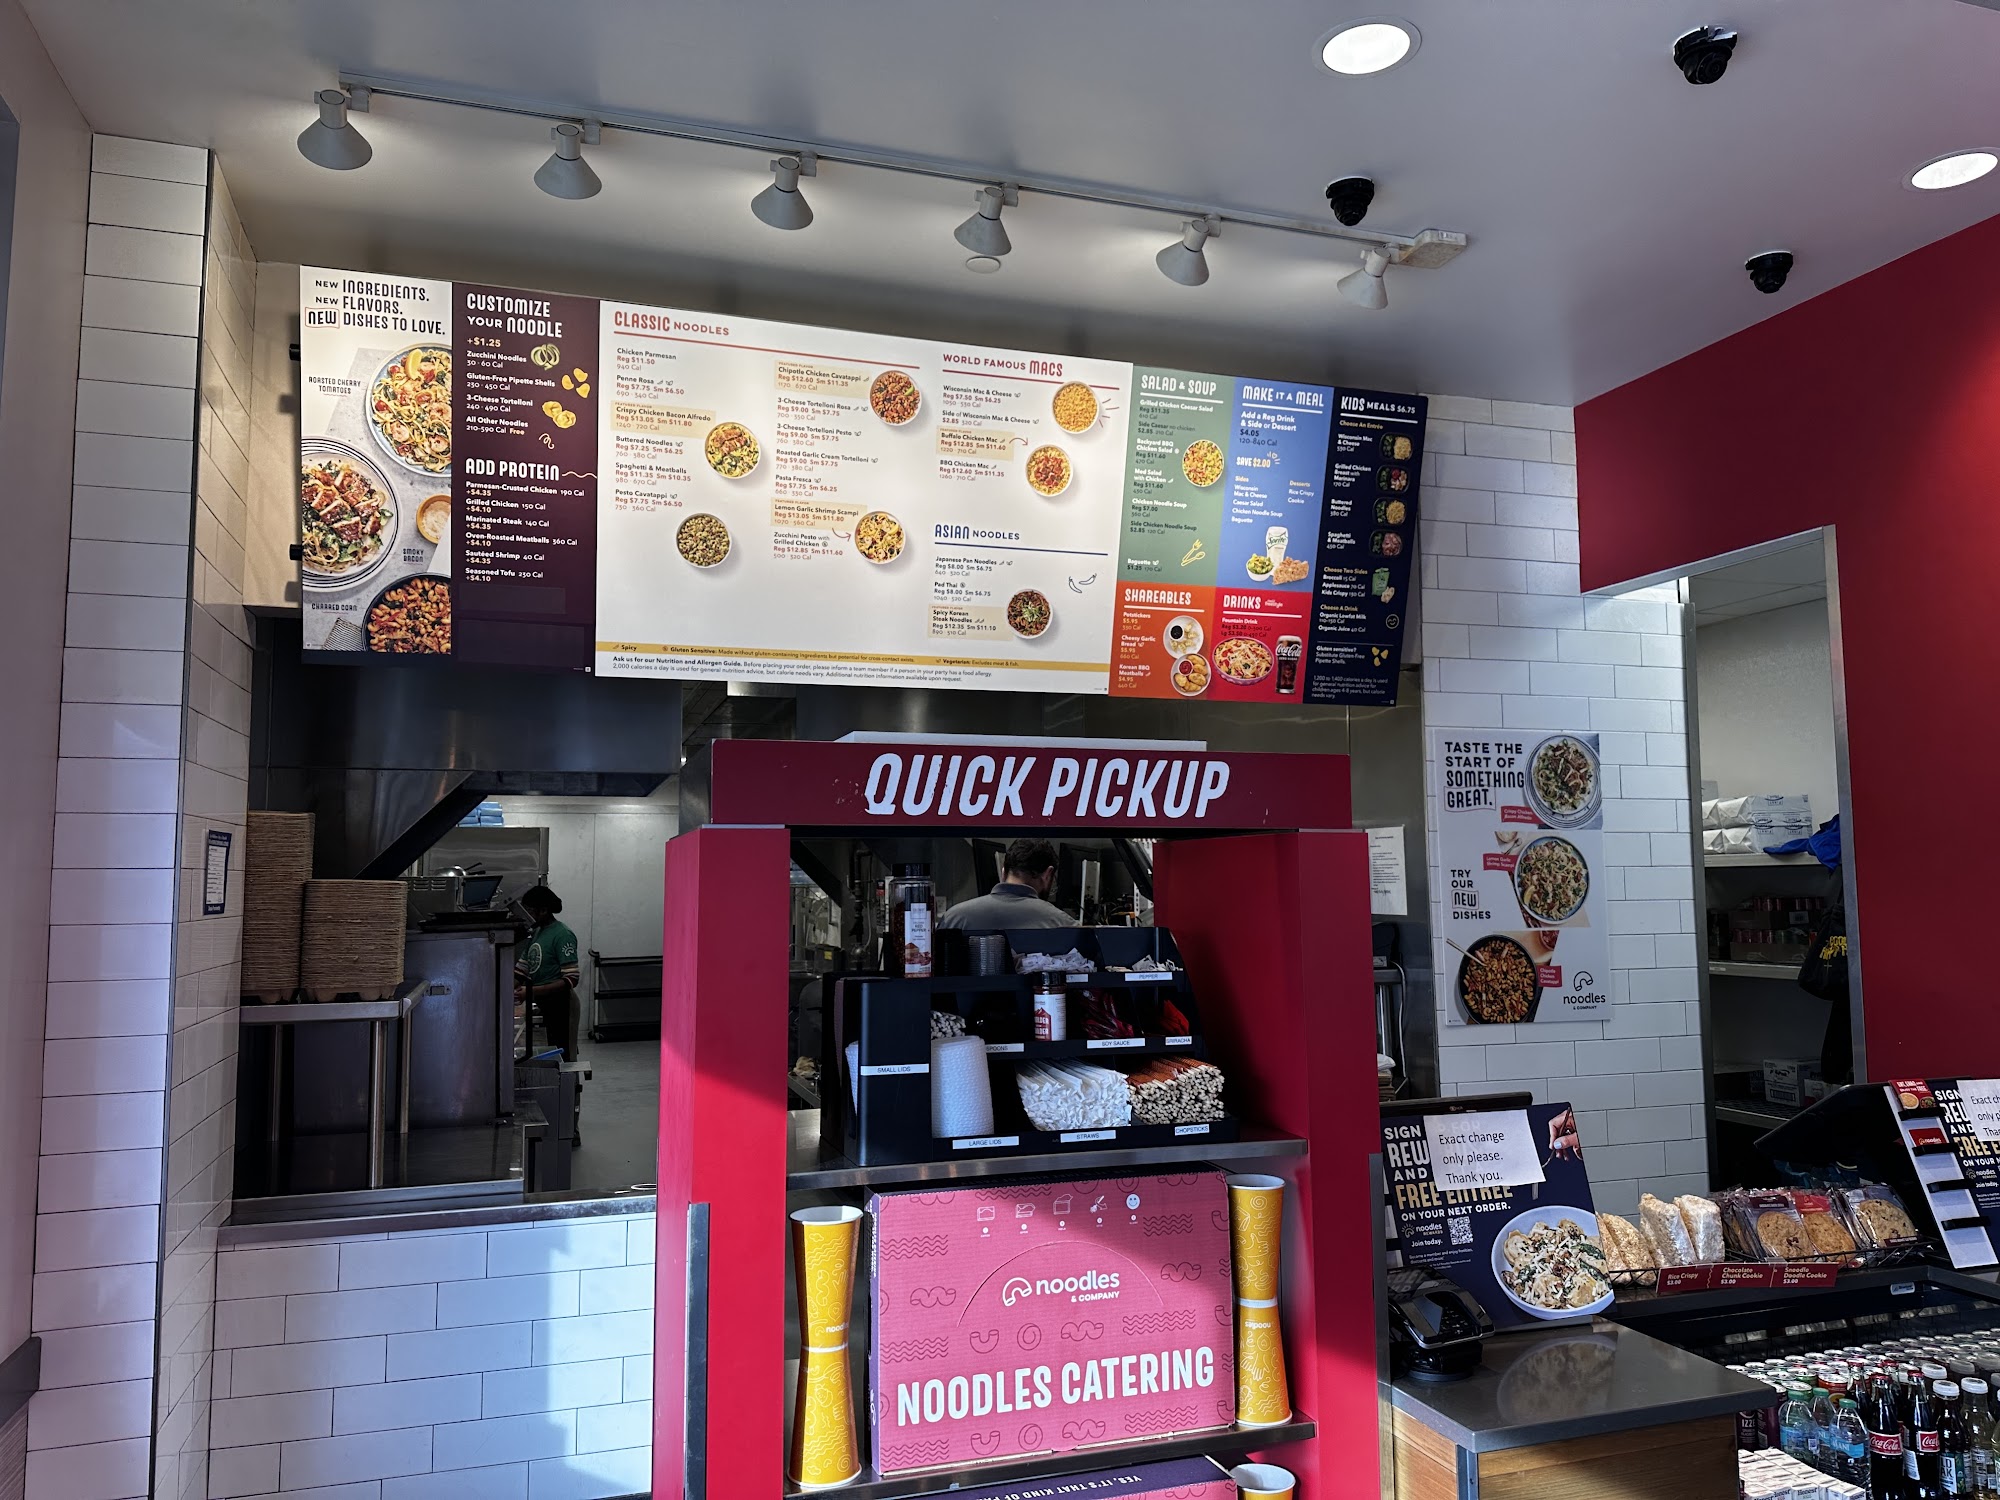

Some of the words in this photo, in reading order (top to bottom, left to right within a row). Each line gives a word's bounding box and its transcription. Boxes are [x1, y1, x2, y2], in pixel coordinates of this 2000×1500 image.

[315, 279, 338, 289] NEW
[342, 279, 429, 302] INGREDIENTS.
[315, 296, 338, 305] NEW
[343, 296, 403, 315] FLAVORS.
[466, 293, 551, 317] CUSTOMIZE
[308, 310, 337, 326] NEW
[343, 313, 390, 330] DISHES
[393, 316, 407, 331] TO
[411, 318, 446, 335] LOVE.
[467, 315, 502, 329] YOUR
[506, 317, 562, 338] NOODLE
[614, 311, 670, 332] CLASSIC
[674, 321, 730, 336] NOODLES
[467, 337, 501, 347] +$1.25
[466, 351, 496, 360] Zucchini
[497, 353, 527, 362] Noodles
[617, 348, 644, 357] Chicken
[645, 350, 677, 360] Parmesan
[617, 355, 630, 364] Reg
[943, 354, 981, 365] WORLD
[984, 358, 1026, 370] FAMOUS
[1029, 360, 1063, 377] MACS
[466, 372, 507, 383] Gluten-Free
[509, 375, 533, 386] Pipette
[534, 378, 555, 387] Shells
[778, 367, 804, 376] Chipotle
[805, 369, 830, 378] Chicken
[831, 372, 861, 382] Cavatappi
[309, 376, 335, 387] ROASTED
[337, 378, 361, 388] CHERRY
[1141, 374, 1177, 392] SALAD
[1179, 382, 1185, 390] &
[1187, 380, 1217, 396] SOUP
[318, 385, 351, 395] TOMATOES
[1243, 385, 1274, 402] MAKE
[1276, 392, 1285, 400] IT
[1286, 393, 1293, 401] A
[1295, 391, 1324, 407] MEAL
[466, 394, 498, 404] 3-Cheese
[499, 396, 533, 406] Tortelloni
[1340, 395, 1365, 412] KIDS
[1366, 402, 1395, 412] MEALS
[1397, 405, 1416, 414] $6.75
[616, 407, 637, 416] Crispy
[638, 408, 665, 417] Chicken
[666, 411, 686, 419] Bacon
[687, 413, 711, 422] Alfredo
[1241, 411, 1256, 420] Add
[1263, 413, 1275, 423] Reg
[1276, 414, 1295, 423] Drink
[1247, 420, 1263, 429] Side
[1271, 422, 1297, 431] Dessert
[1240, 428, 1259, 437] $4.05
[616, 435, 644, 444] Buttered
[645, 438, 673, 447] Noodles
[1236, 456, 1252, 467] SAVE
[1253, 457, 1271, 468] $2.00
[466, 458, 495, 476] ADD
[499, 460, 560, 481] PROTEIN
[466, 481, 528, 493] Parmesan-Crusted
[530, 485, 557, 495] Chicken
[574, 488, 585, 496] Cal
[466, 498, 489, 508] Grilled
[491, 500, 519, 509] Chicken
[815, 507, 836, 515] Shrimp
[837, 509, 859, 517] Scampi
[934, 524, 970, 540] ASIAN
[972, 530, 1020, 540] NOODLES
[403, 548, 424, 556] SMOKY
[403, 554, 424, 563] BACON
[935, 556, 962, 565] Japanese
[974, 558, 997, 566] Noodles
[1124, 588, 1192, 606] SHAREABLES
[1223, 594, 1261, 609] DRINKS
[312, 603, 339, 611] CHARRED
[341, 604, 358, 612] CORN
[1444, 741, 1490, 754] TASTE
[1495, 743, 1523, 754] THE
[1445, 756, 1492, 768] START
[1496, 757, 1515, 768] OF
[1446, 770, 1524, 788] SOMETHING
[864, 753, 1037, 817] QUICK
[1041, 757, 1231, 819] PICKUP
[1447, 788, 1493, 808] GREAT.
[1450, 869, 1471, 878] TRY
[1451, 880, 1474, 888] OUR
[1454, 891, 1477, 907] NEW
[1453, 911, 1491, 920] DISHES
[1563, 992, 1606, 1005] noodles
[1970, 1095, 1992, 1105] Exact
[1977, 1111, 1994, 1121] only
[1175, 1126, 1209, 1134] CHOPSTICKS
[1384, 1124, 1421, 1140] SIGN
[1439, 1134, 1466, 1145] Exact
[1468, 1131, 1505, 1144] change
[1442, 1154, 1464, 1166] only
[1467, 1152, 1503, 1166] please.
[1963, 1159, 1974, 1167] ON
[1975, 1158, 1994, 1166] YOUR
[1394, 1168, 1428, 1182] AND
[1446, 1172, 1478, 1184] Thank
[1479, 1172, 1503, 1184] you.
[1396, 1182, 1443, 1209] FREE
[1401, 1212, 1416, 1221] ON
[1418, 1210, 1445, 1220] YOUR
[1448, 1206, 1472, 1217] NEXT
[1475, 1201, 1511, 1213] ORDER.
[1416, 1223, 1442, 1233] noodles
[1411, 1240, 1424, 1248] Join
[1424, 1238, 1443, 1247] today.
[1681, 1272, 1699, 1280] Crispy
[1036, 1270, 1120, 1295] noodles
[1078, 1291, 1120, 1303] COMPANY
[897, 1365, 1052, 1427] NOODLES
[1061, 1346, 1214, 1404] CATERING
[1090, 1480, 1113, 1489] IT'S
[1114, 1475, 1142, 1485] YES,
[1022, 1488, 1054, 1499] KIND
[1056, 1483, 1089, 1494] THAT
